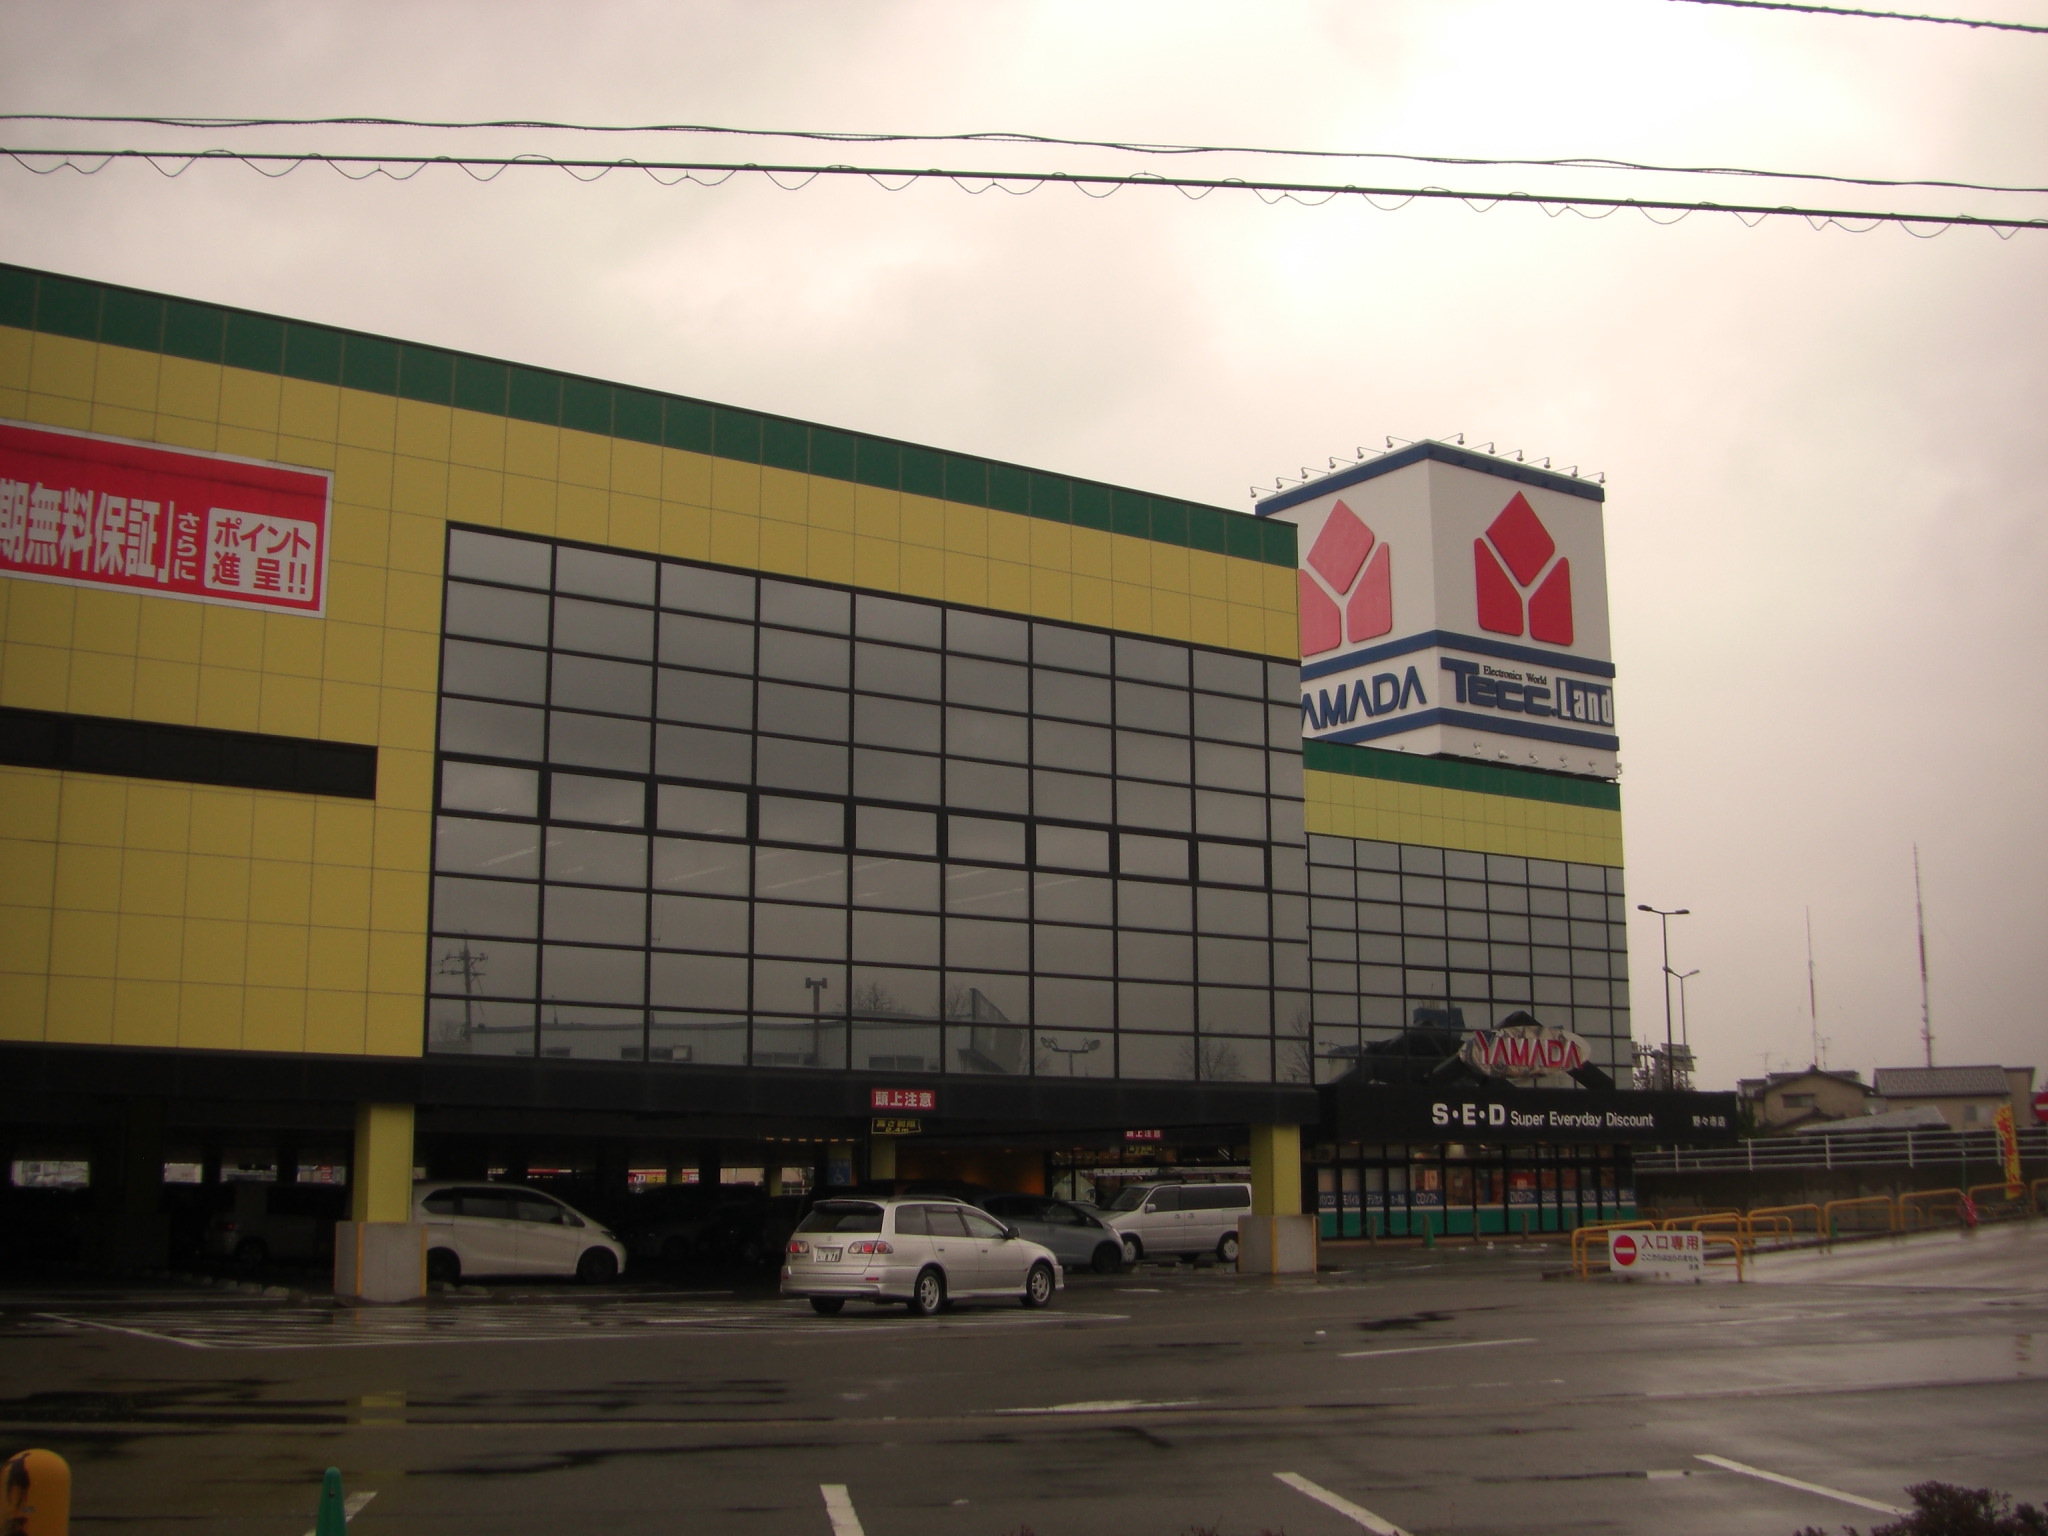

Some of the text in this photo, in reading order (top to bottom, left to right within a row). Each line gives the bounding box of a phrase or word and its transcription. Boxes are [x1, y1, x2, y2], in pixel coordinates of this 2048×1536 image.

[173, 512, 200, 581] さらに
[214, 517, 311, 558] ポイント
[1483, 664, 1547, 686] Electronics World
[1475, 1030, 1583, 1069] YAMADA
[875, 1091, 932, 1107] 頭上注意
[1510, 1110, 1545, 1128] Super
[1549, 1111, 1602, 1128] Everyday
[1606, 1111, 1654, 1128] Discount
[1641, 1234, 1699, 1250] 入口専用
